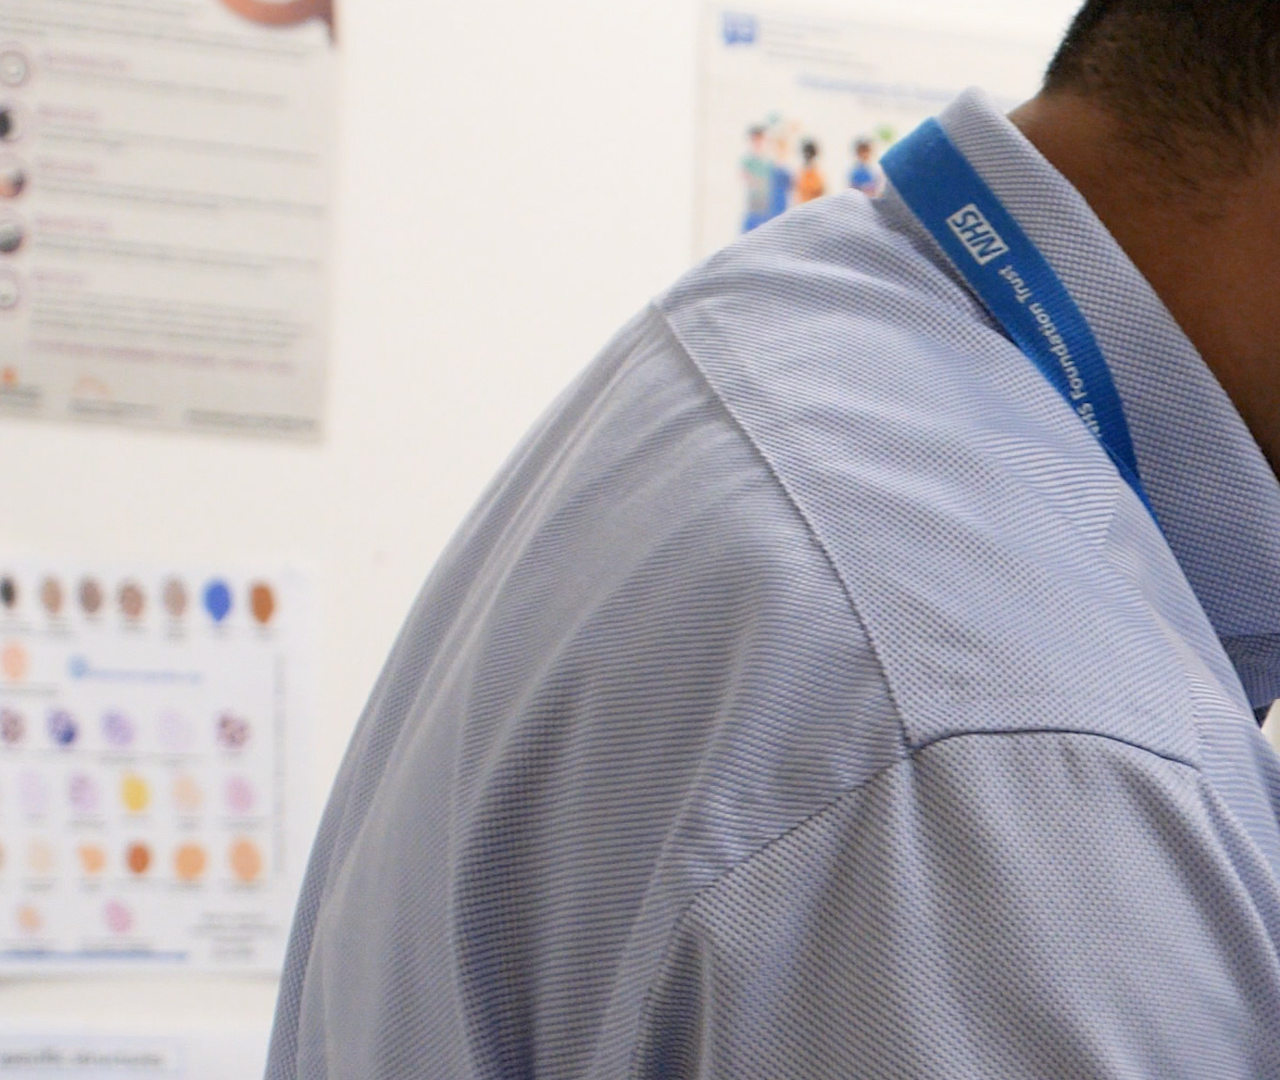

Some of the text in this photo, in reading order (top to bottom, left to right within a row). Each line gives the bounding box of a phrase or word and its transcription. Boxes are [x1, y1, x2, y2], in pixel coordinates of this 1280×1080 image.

[950, 207, 1006, 261] NHS
[998, 264, 1032, 304] Trust
[1029, 302, 1088, 400] Foundation
